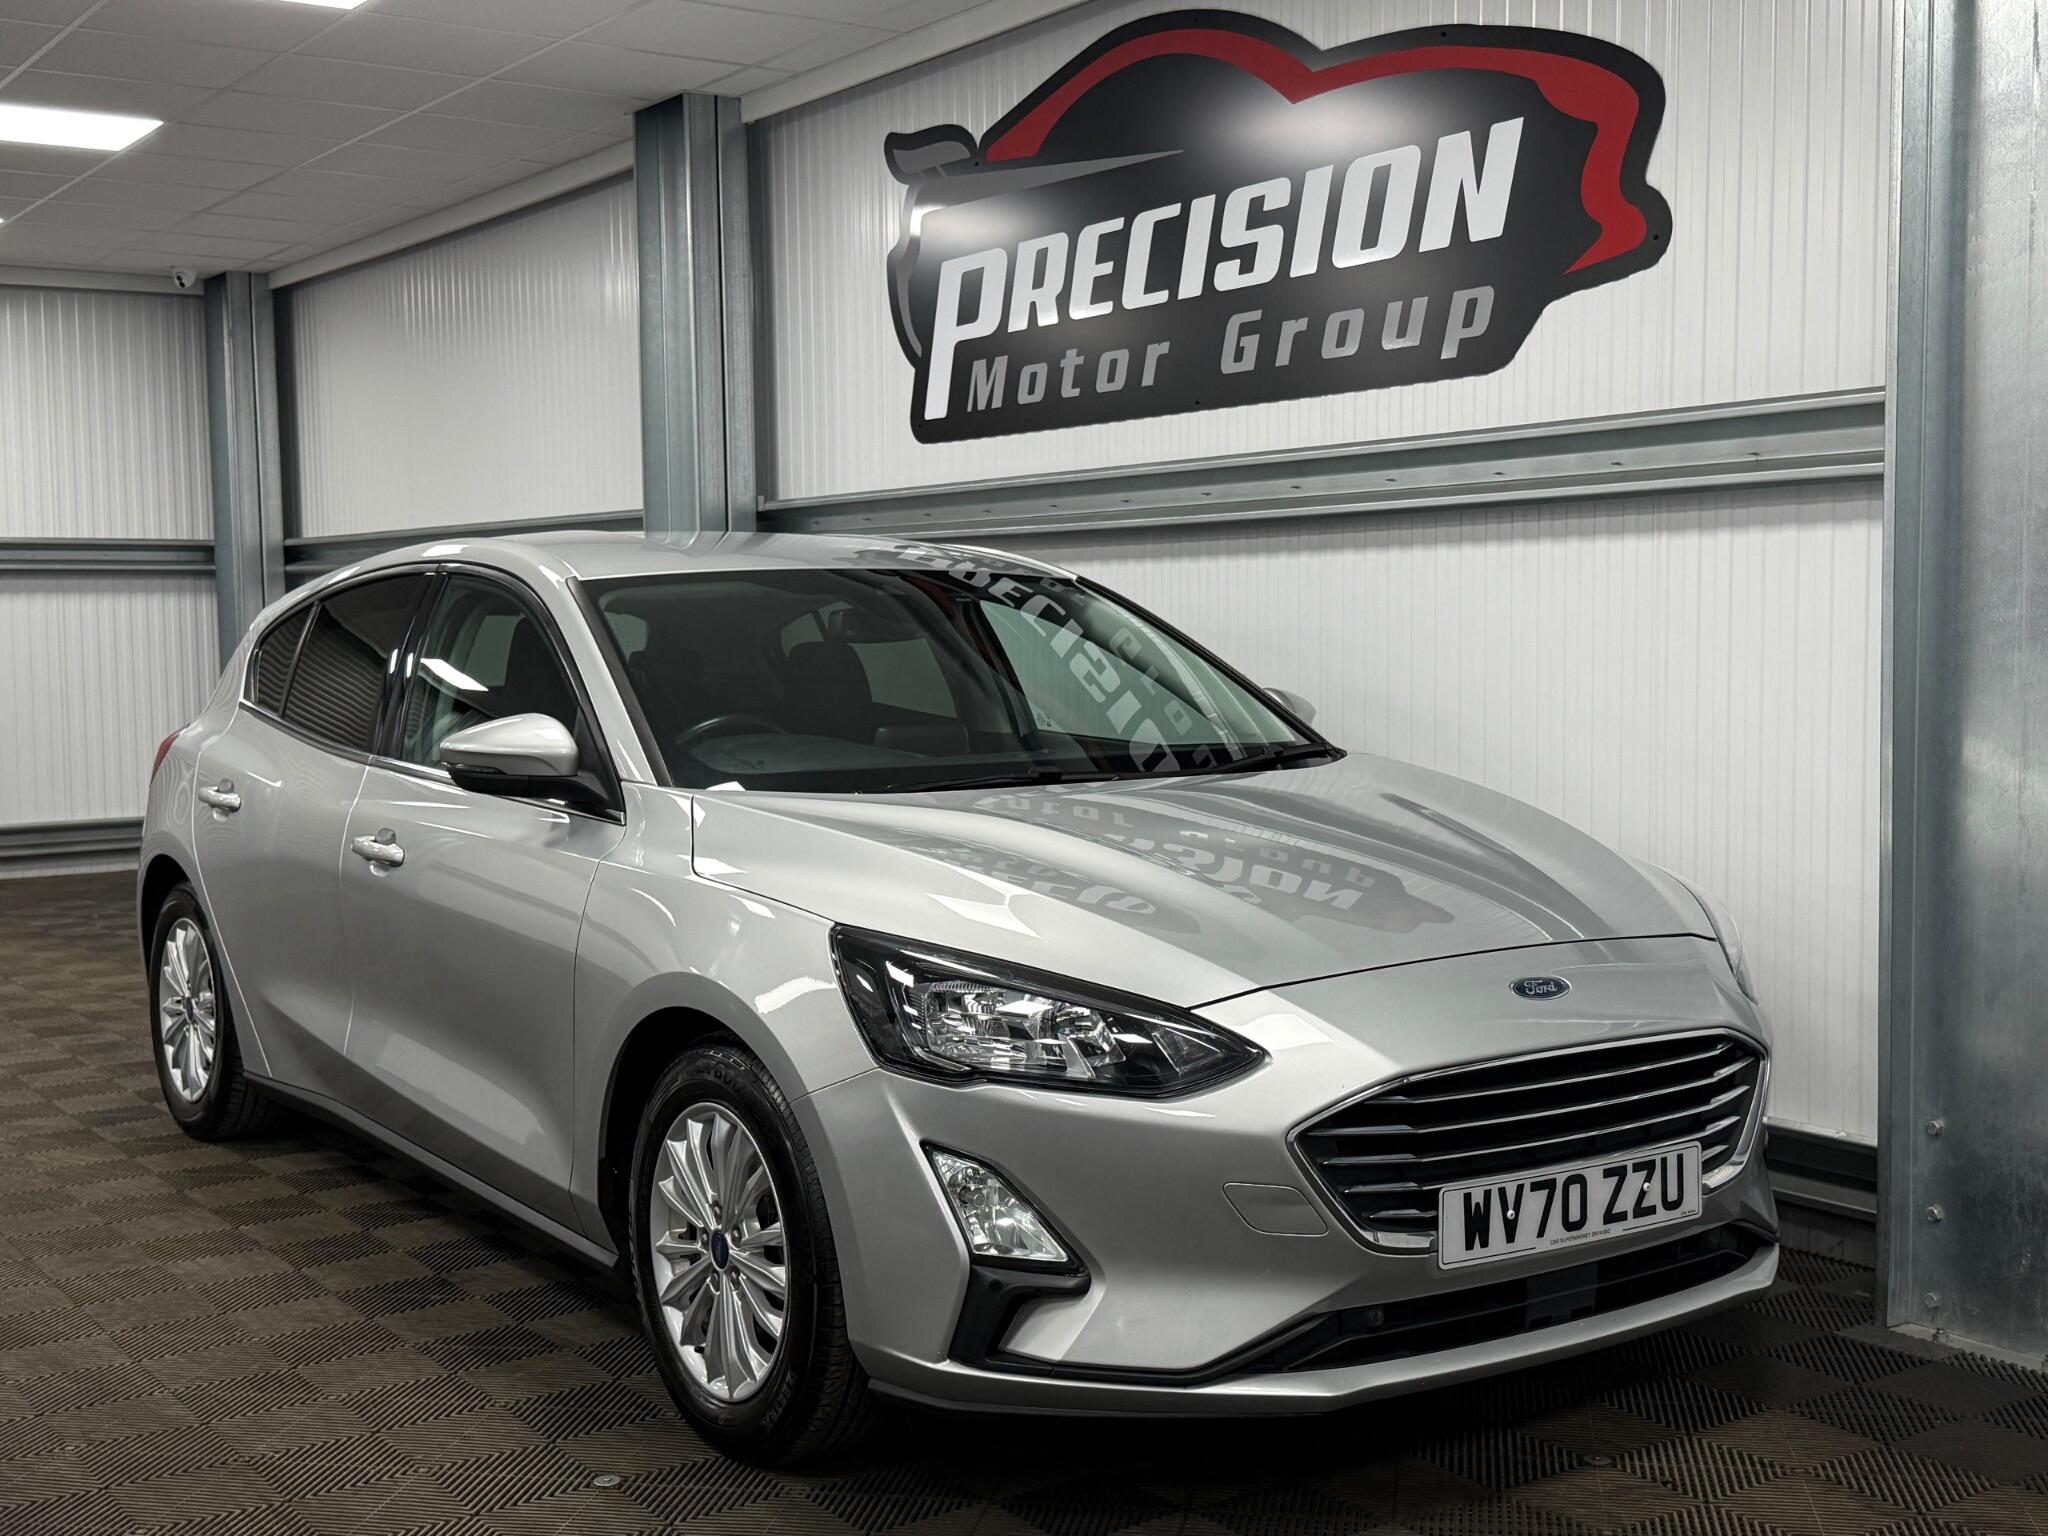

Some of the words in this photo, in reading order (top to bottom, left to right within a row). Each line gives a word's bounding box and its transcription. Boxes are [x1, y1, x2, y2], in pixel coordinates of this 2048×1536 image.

[923, 117, 1525, 420] PRECISION
[966, 338, 1170, 414] Motor
[1220, 285, 1496, 376] Group
[1523, 979, 1558, 995] Ford
[1463, 1173, 1588, 1251] WV70
[1602, 1153, 1684, 1226] ZZU
